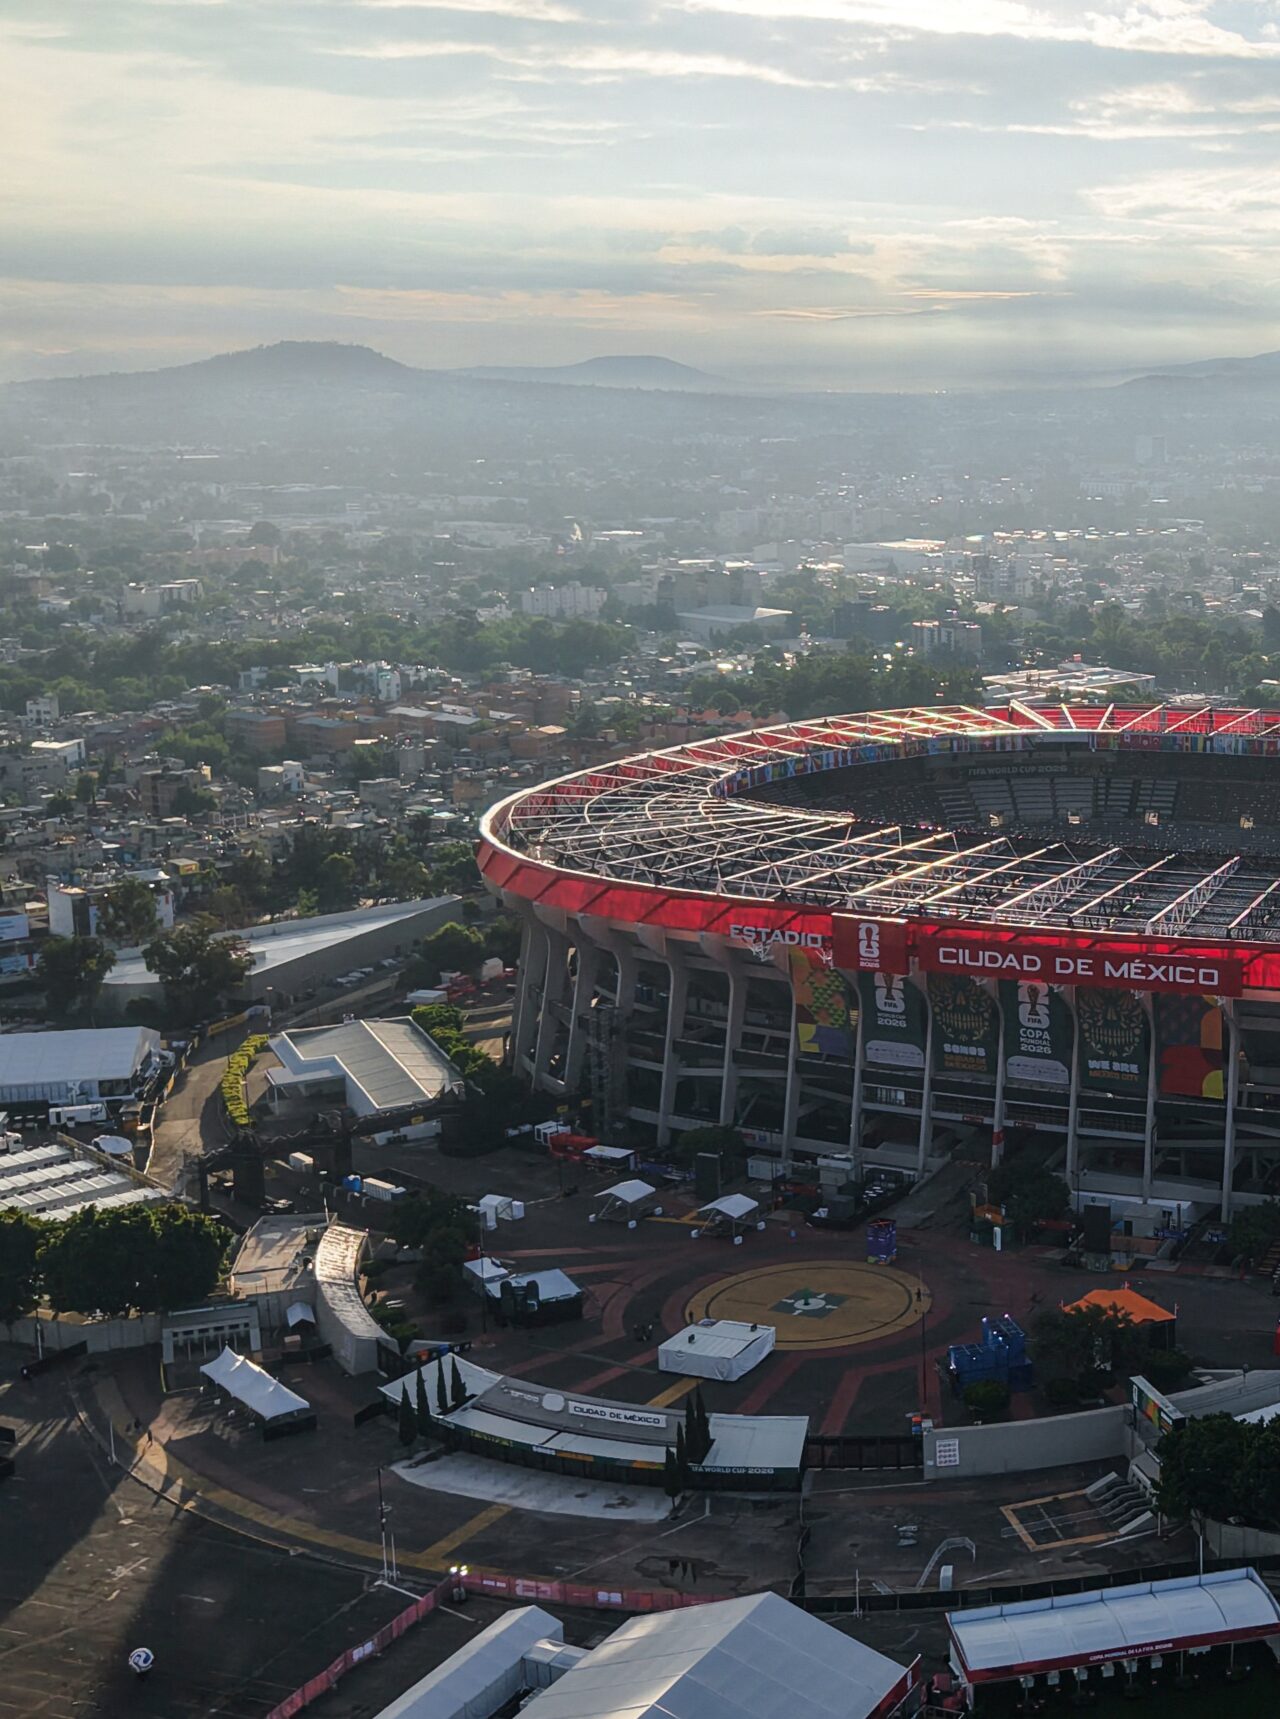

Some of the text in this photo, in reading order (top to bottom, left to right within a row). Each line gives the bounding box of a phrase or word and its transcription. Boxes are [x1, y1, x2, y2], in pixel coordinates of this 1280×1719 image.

[988, 766, 1018, 775] WORLD
[1020, 766, 1036, 774] CUP
[1038, 764, 1068, 773] 2026
[729, 924, 822, 948] ESTADIO
[938, 947, 1219, 986] CIUDAD DE MÉXICO
[884, 1001, 898, 1009] FIFA
[878, 1018, 907, 1028] 2026
[1027, 1016, 1042, 1024] FIFA
[1020, 1028, 1050, 1040] COPA
[1020, 1044, 1052, 1054] 2026
[574, 1406, 660, 1424] CIUDAD DE MÉXICO
